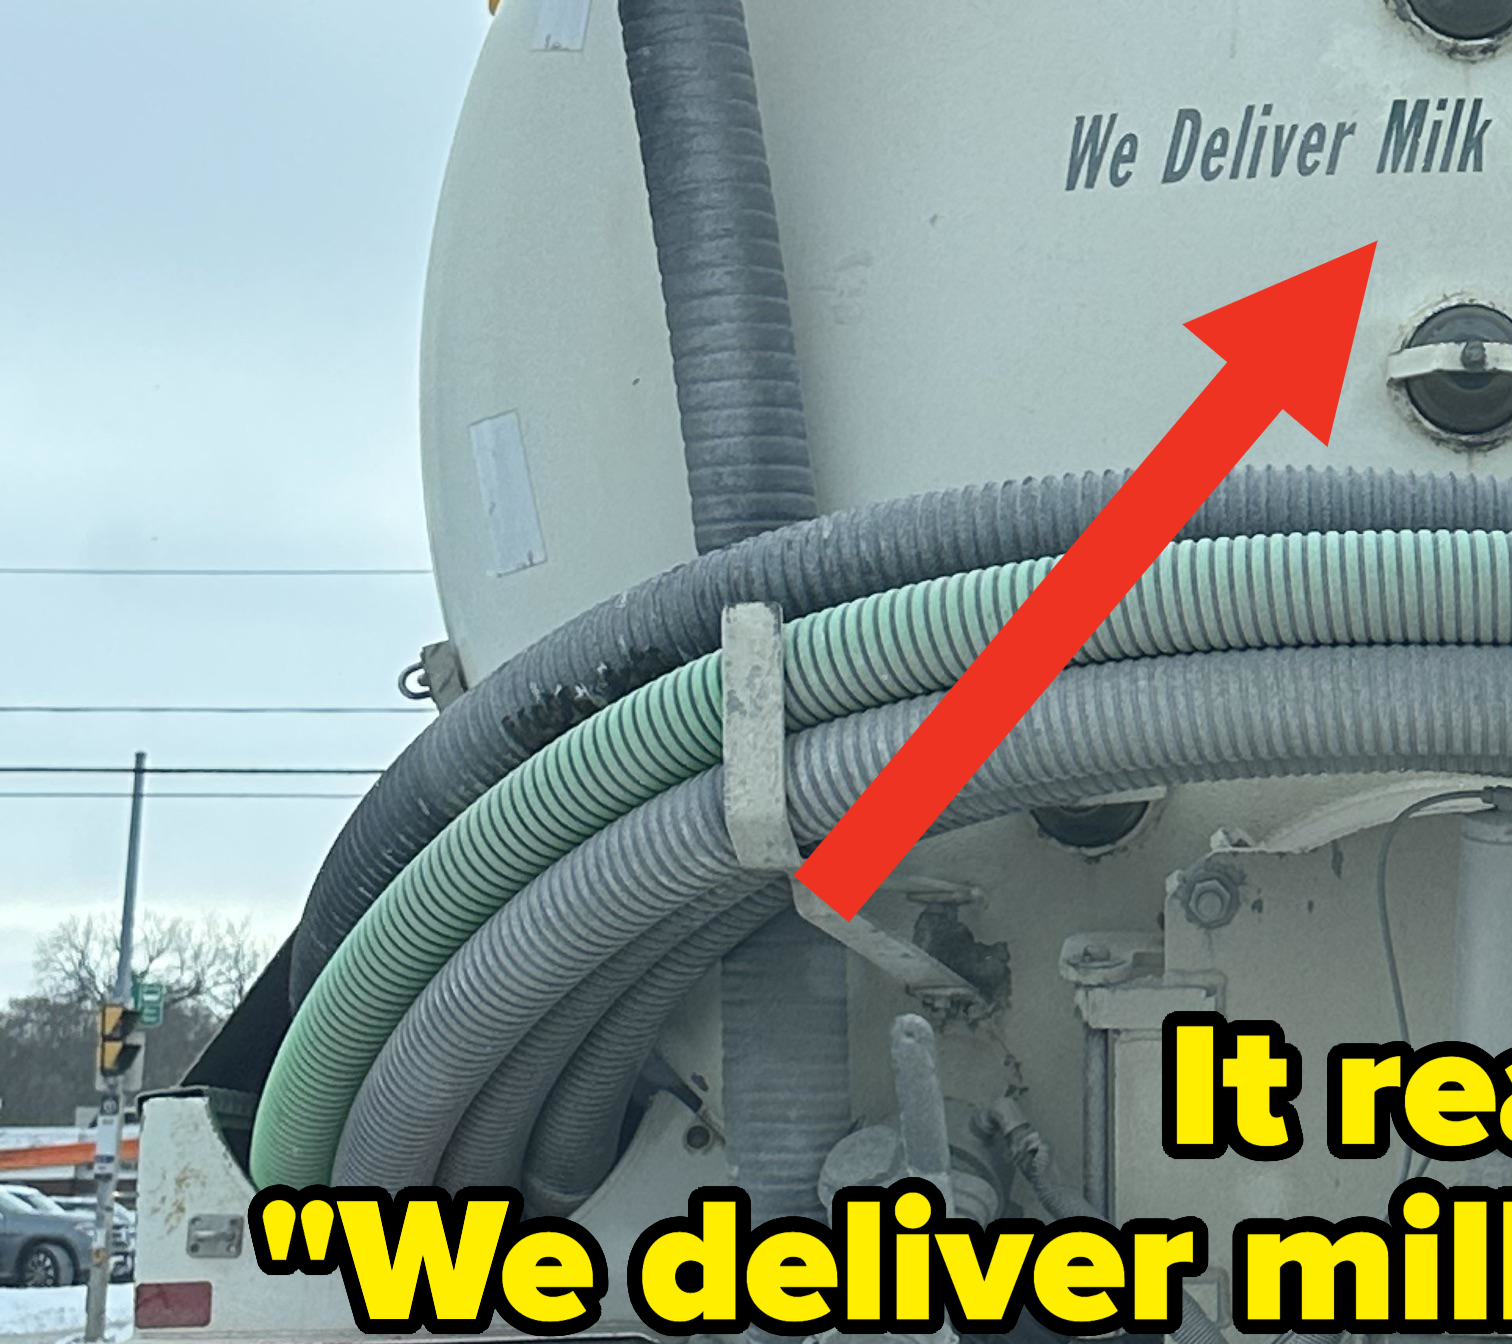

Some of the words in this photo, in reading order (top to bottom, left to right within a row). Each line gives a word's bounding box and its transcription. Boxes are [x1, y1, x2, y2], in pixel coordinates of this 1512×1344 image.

[1065, 112, 1139, 192] We
[1162, 104, 1357, 186] Deliver
[1376, 98, 1493, 175] Milk
